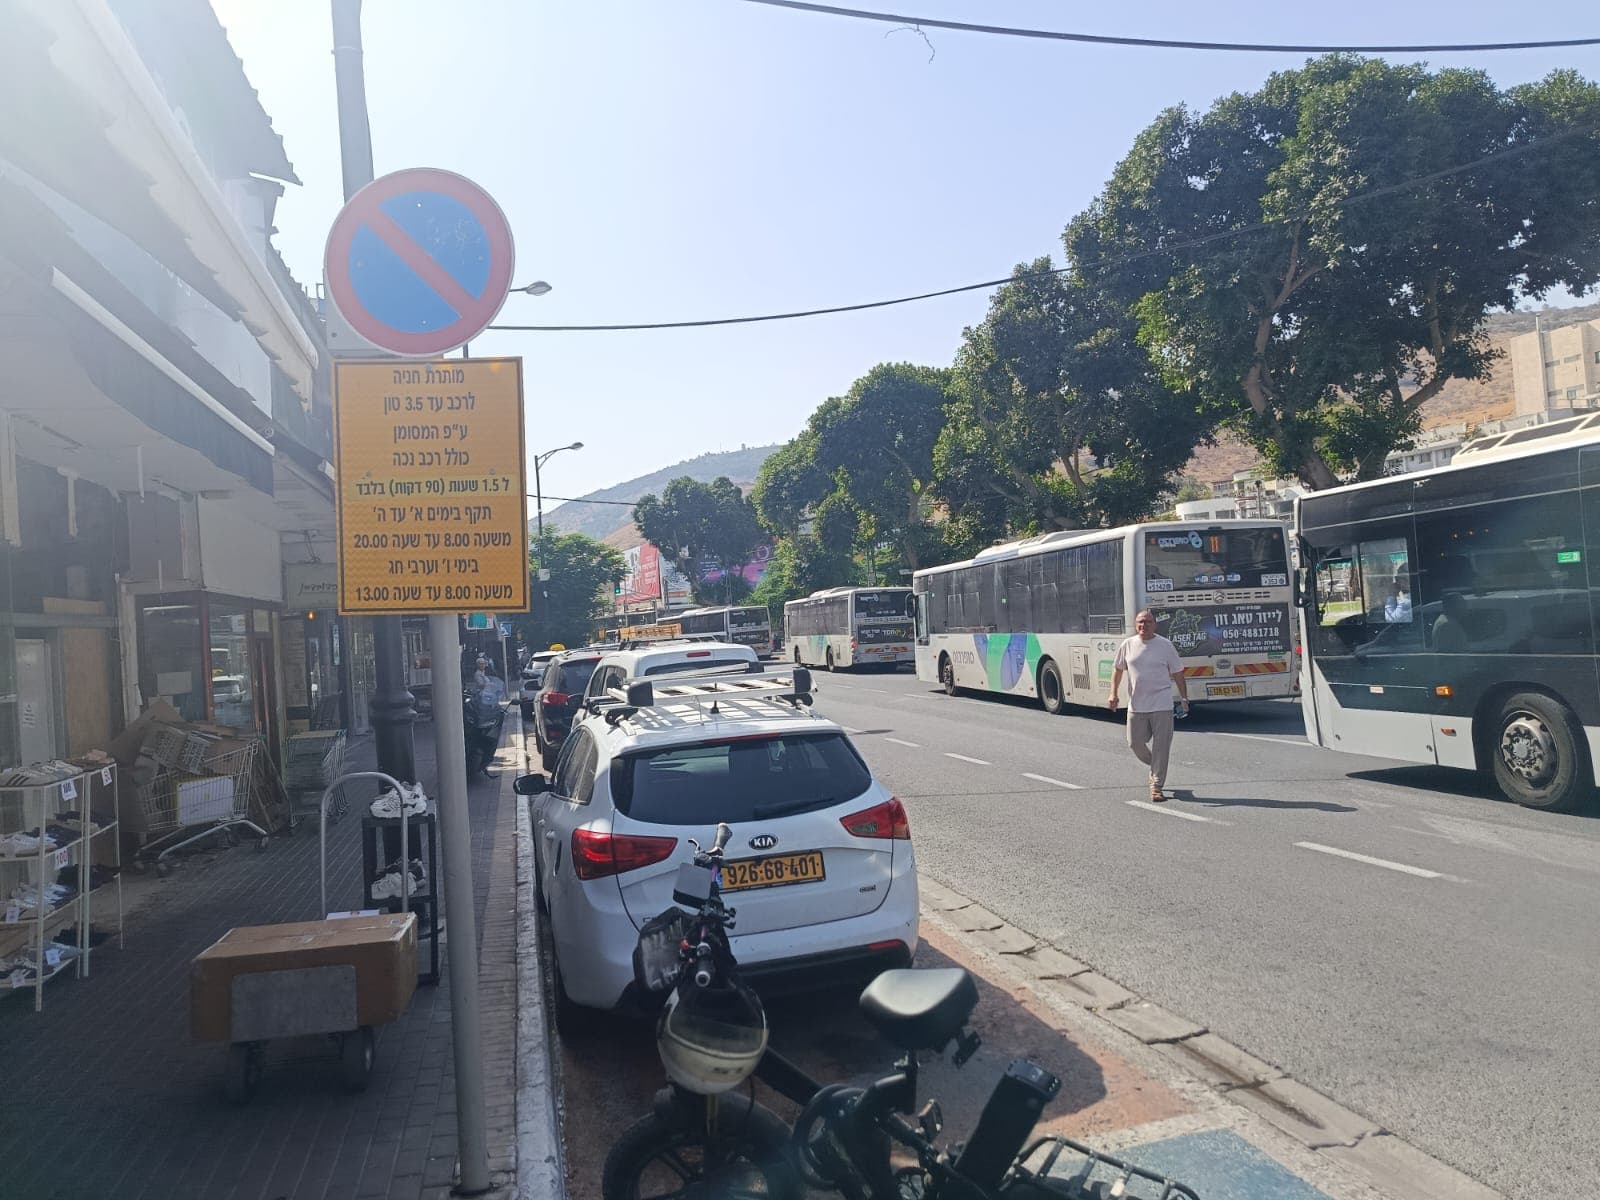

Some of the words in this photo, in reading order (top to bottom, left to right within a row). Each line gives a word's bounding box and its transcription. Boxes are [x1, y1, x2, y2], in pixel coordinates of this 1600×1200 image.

[393, 369, 420, 385] חניה
[425, 368, 464, 384] מותרת
[384, 396, 400, 416] טון
[405, 396, 423, 411] 3.5
[428, 396, 443, 412] עד
[447, 392, 476, 411] לרכב
[394, 425, 439, 443] המסומן
[392, 451, 415, 467] נכה
[418, 451, 441, 466] רכב
[444, 447, 470, 466] כולל
[356, 480, 385, 496] בלבד
[389, 479, 422, 496] דקות)
[425, 478, 445, 495] (90
[448, 479, 478, 493] שעות
[483, 478, 500, 492] 1.5
[390, 507, 406, 523] עד
[427, 506, 461, 521] בימים
[464, 505, 492, 524] תקף
[353, 534, 388, 549] 20.00
[392, 534, 421, 549] שעה
[425, 533, 440, 549] עד
[444, 533, 470, 547] 8.00
[473, 531, 512, 548] משעה
[388, 559, 404, 575] חג
[407, 558, 439, 575] וערבי
[454, 558, 479, 573] בימי
[356, 586, 389, 602] 13.00
[393, 586, 421, 602] שעה
[425, 586, 441, 602] עד
[445, 586, 470, 600] 8.00
[474, 584, 513, 601] משעה
[1214, 614, 1229, 627] זון
[1231, 612, 1252, 625] טאג
[1257, 609, 1282, 623] לייזר
[1168, 632, 1191, 643] LASER
[1192, 632, 1207, 641] TAG
[1223, 628, 1279, 639] 050-4881718
[753, 836, 775, 848] KIA
